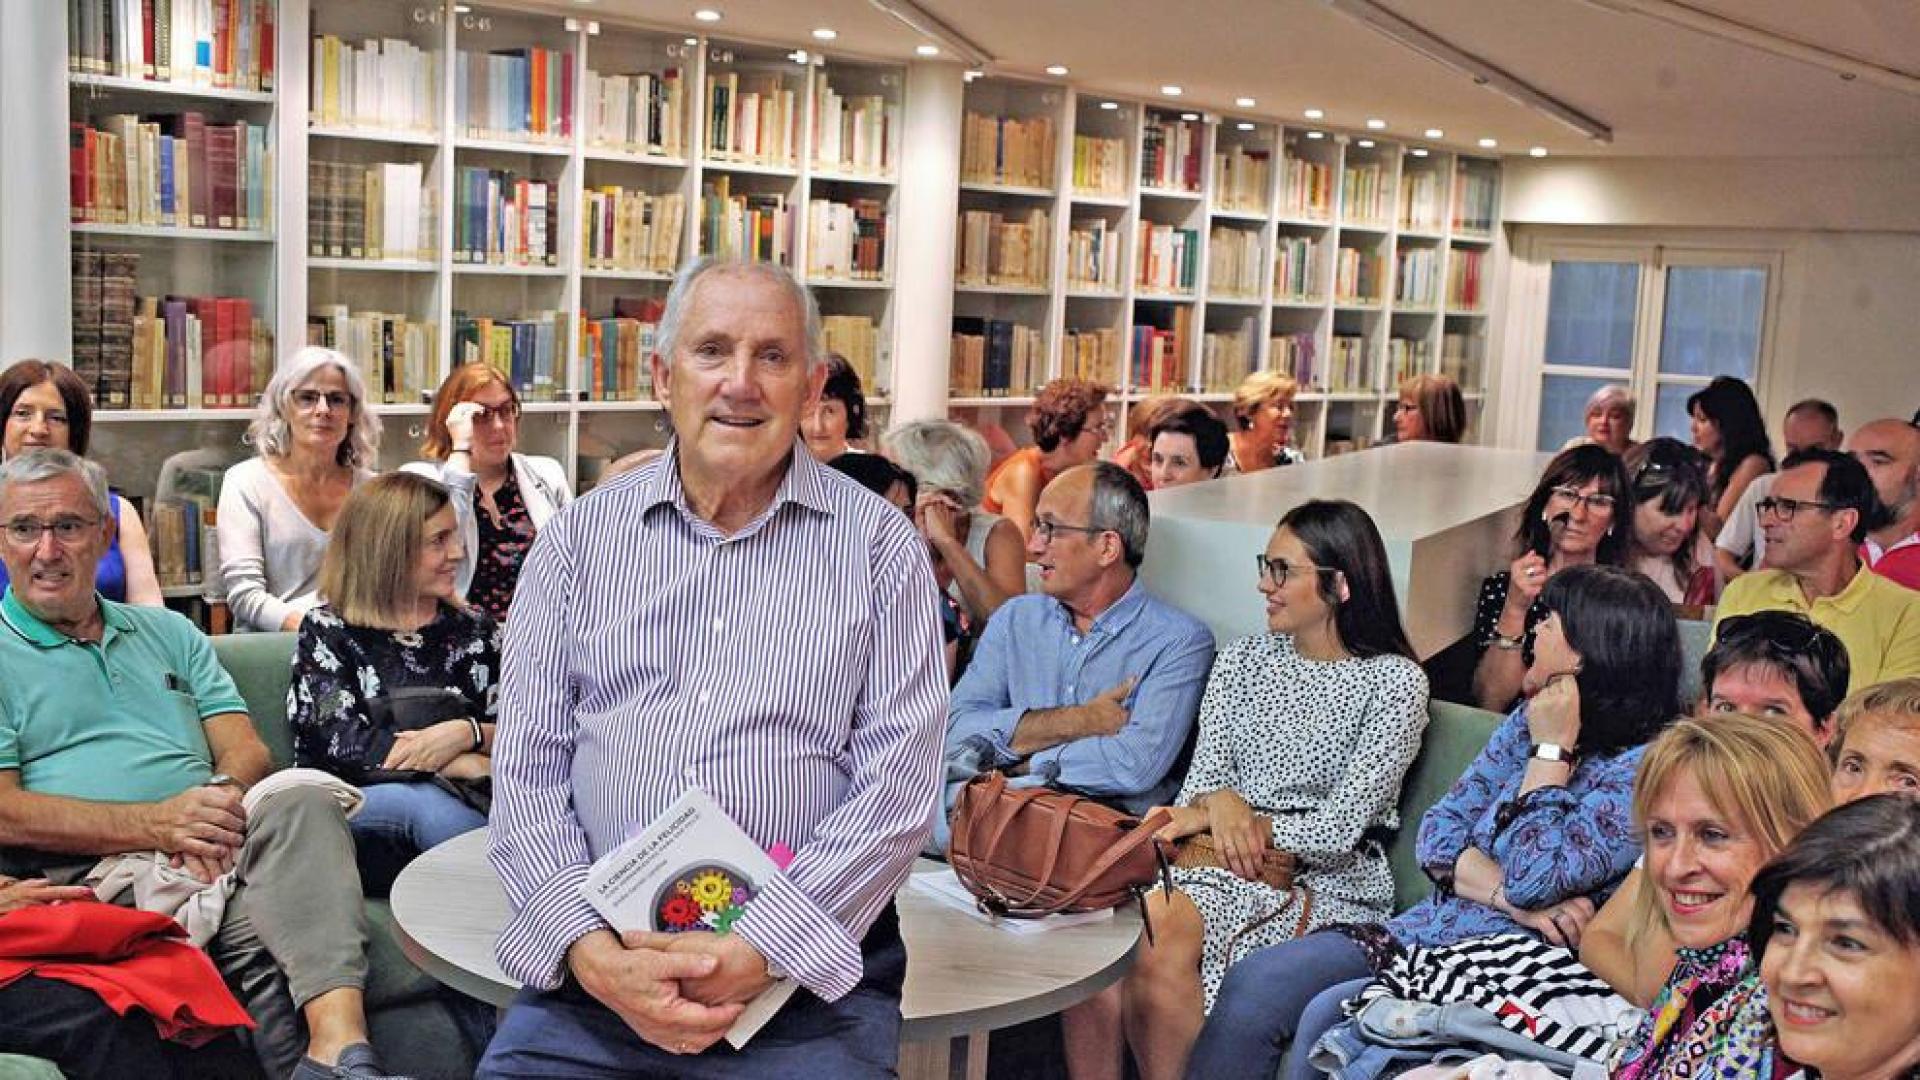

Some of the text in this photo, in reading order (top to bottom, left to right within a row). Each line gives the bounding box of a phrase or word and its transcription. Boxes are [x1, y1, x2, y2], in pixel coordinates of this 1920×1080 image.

[598, 806, 696, 894] LA CIENCIA DE LA FELICIDAD
